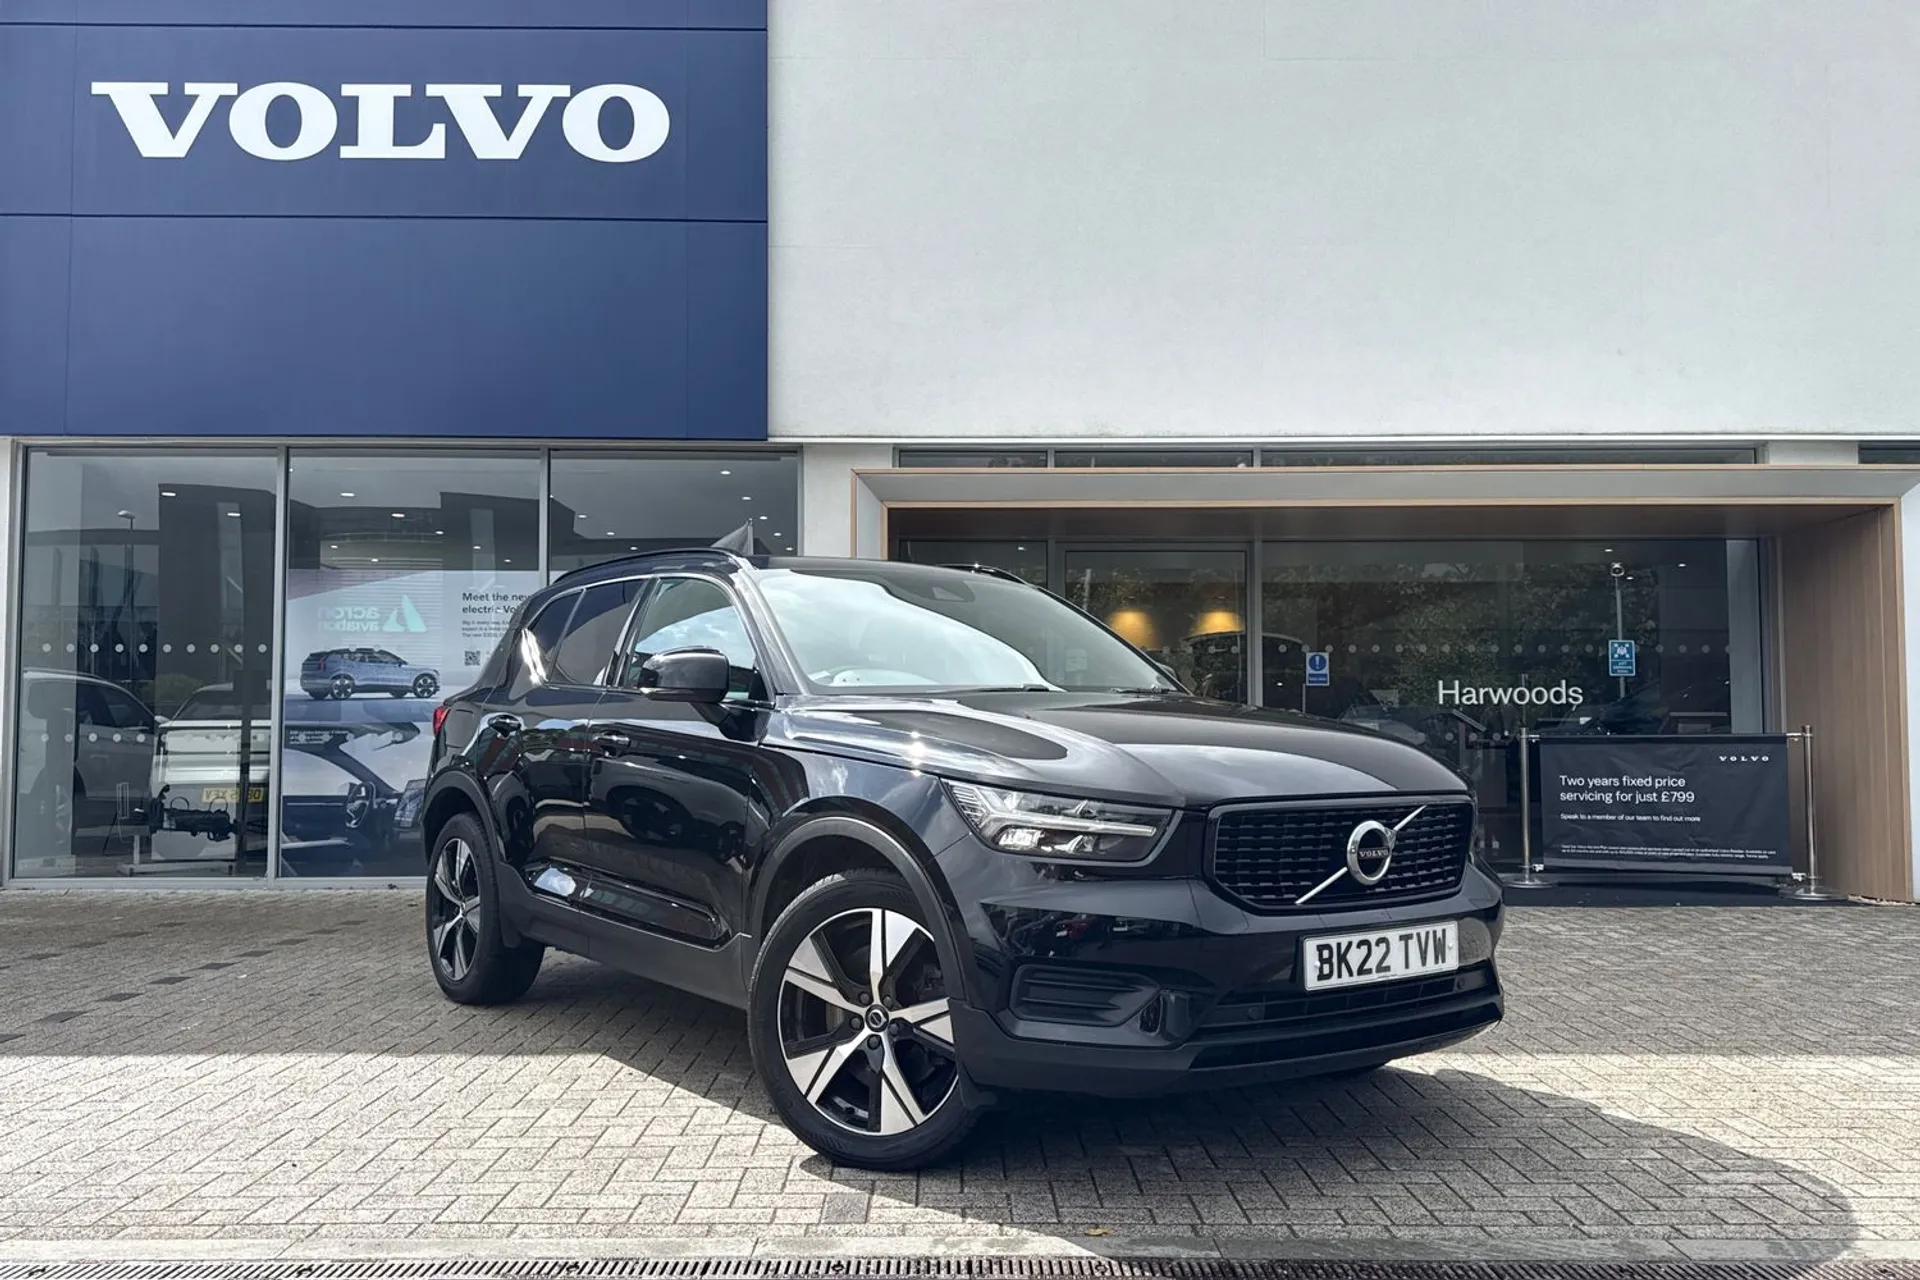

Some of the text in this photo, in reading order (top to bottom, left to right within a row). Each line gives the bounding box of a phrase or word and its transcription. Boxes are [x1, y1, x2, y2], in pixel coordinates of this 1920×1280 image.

[91, 81, 670, 162] VOLVO
[462, 592, 489, 601] Meet
[492, 592, 509, 601] the
[1438, 679, 1584, 705] Harwoods
[1560, 775, 1686, 789] Two years fixed price
[1560, 790, 1695, 804] servicing for just £799
[1359, 849, 1389, 858] VOLVO
[1316, 928, 1447, 982] BK22 TVW
